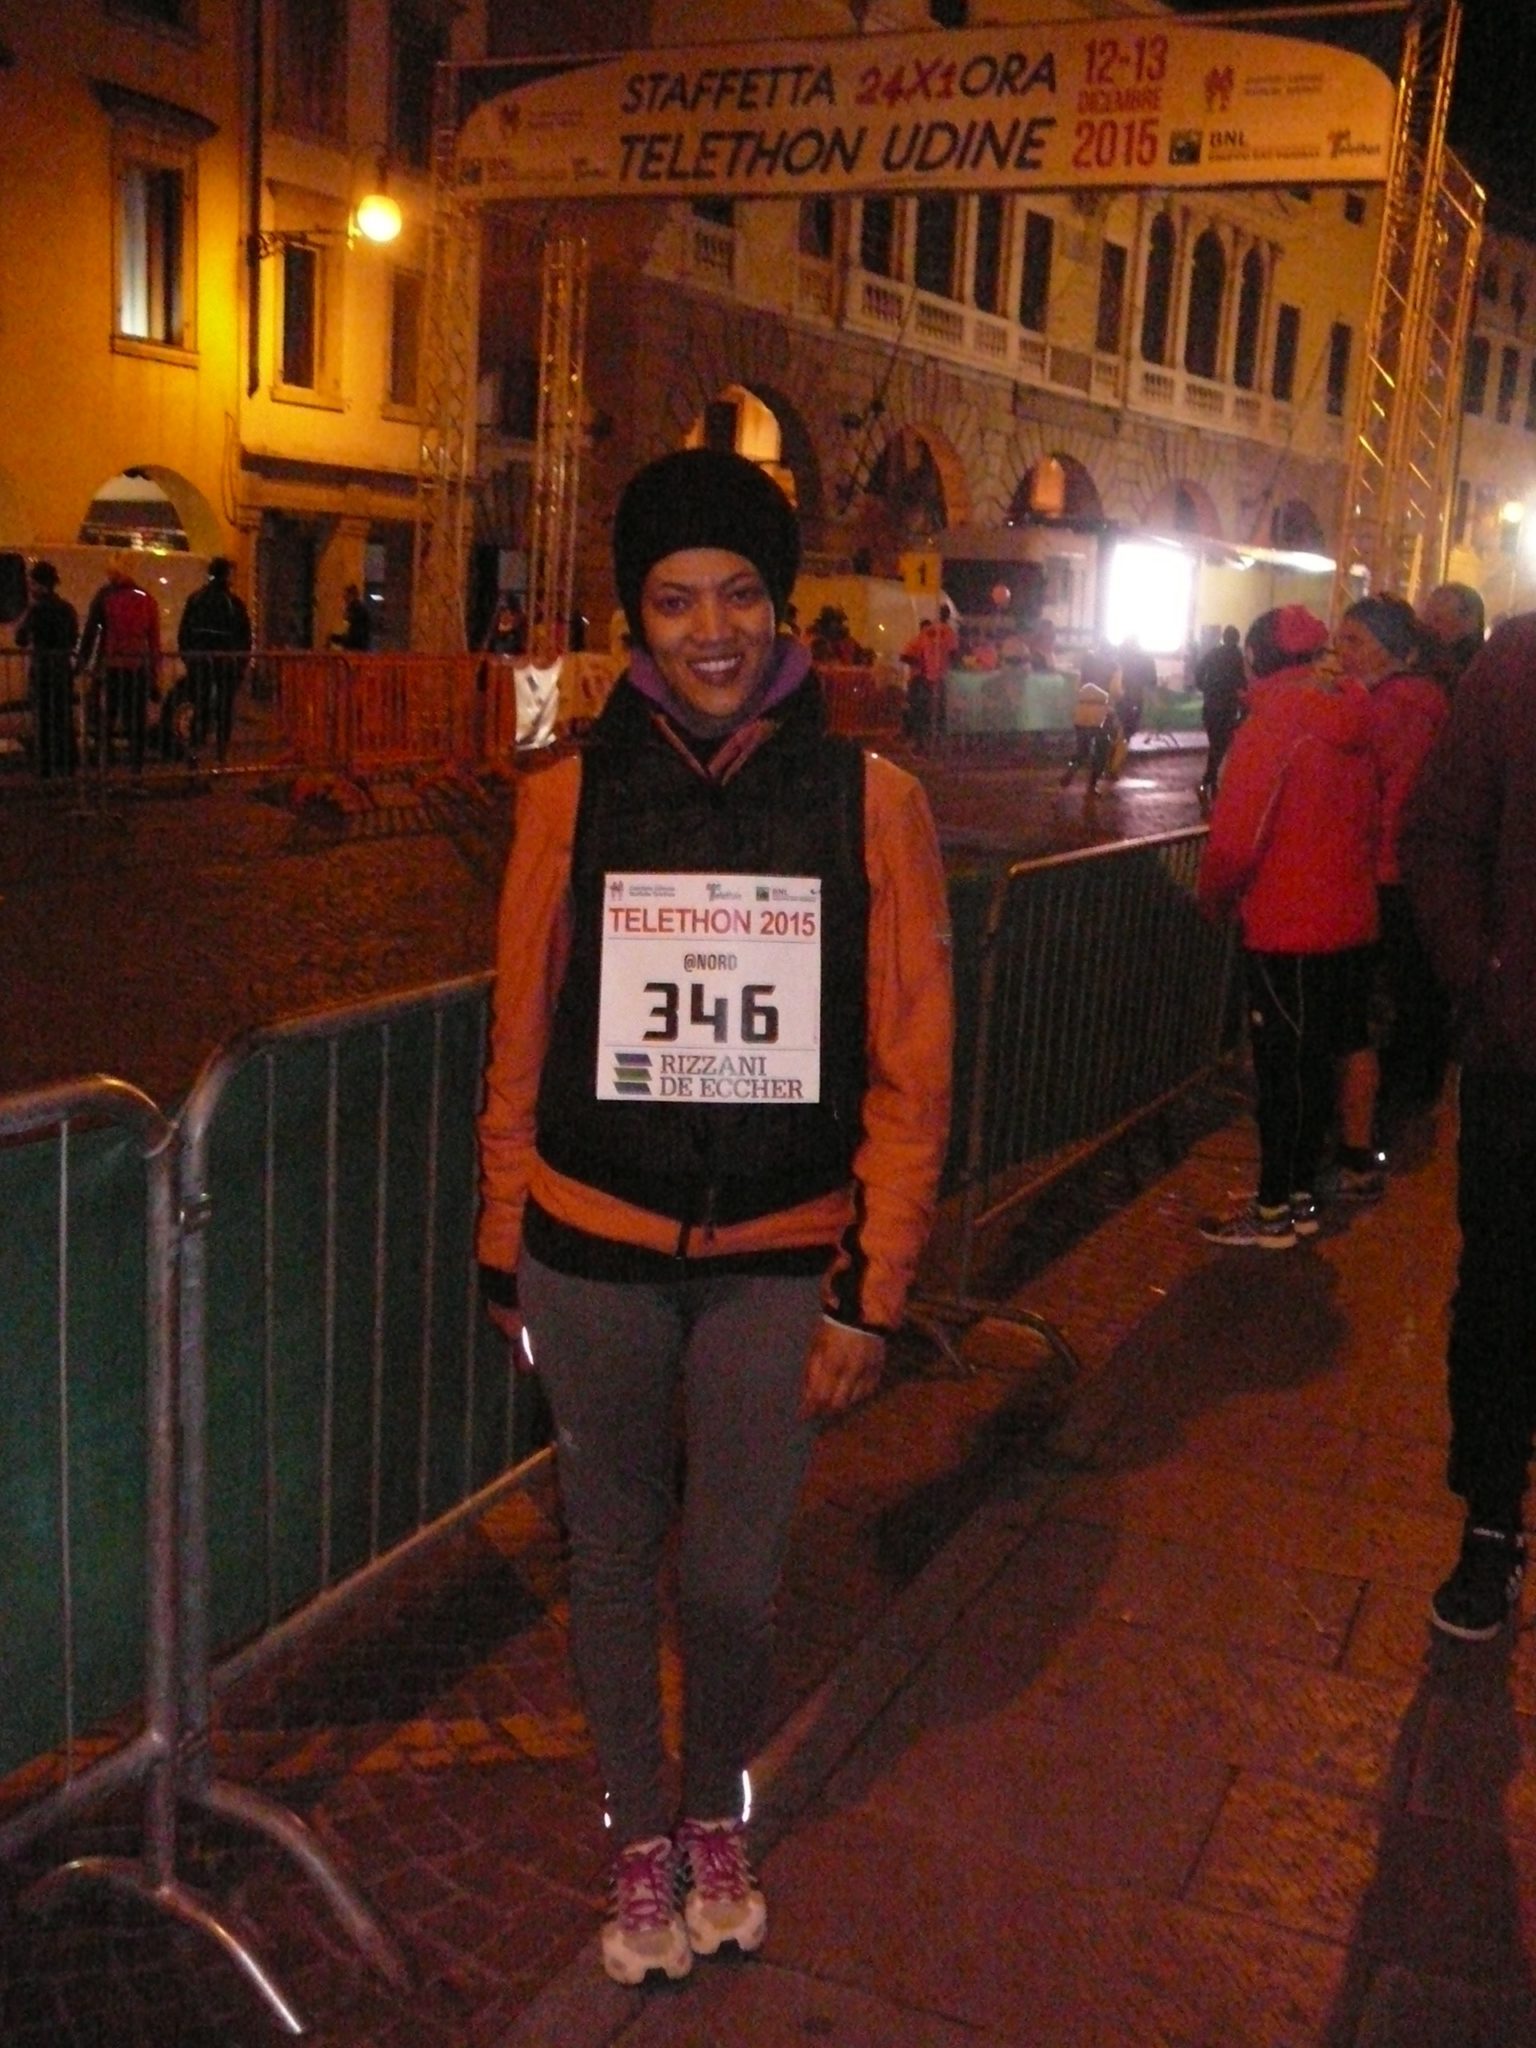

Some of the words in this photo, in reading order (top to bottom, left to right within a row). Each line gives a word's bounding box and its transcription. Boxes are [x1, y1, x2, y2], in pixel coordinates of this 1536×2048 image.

[1085, 34, 1168, 84] 12-13
[621, 65, 836, 114] STAFFETTA
[619, 126, 868, 181] TELETHON
[882, 116, 1057, 172] UDINE
[1072, 118, 1159, 168] 2015
[609, 907, 751, 935] TELETHON
[760, 910, 816, 936] 2015
[684, 954, 737, 972] @NORD
[642, 982, 779, 1044] 346
[660, 1076, 692, 1096] DE
[701, 1078, 803, 1098] ECCHER
[661, 1054, 767, 1076] RIZZANI
